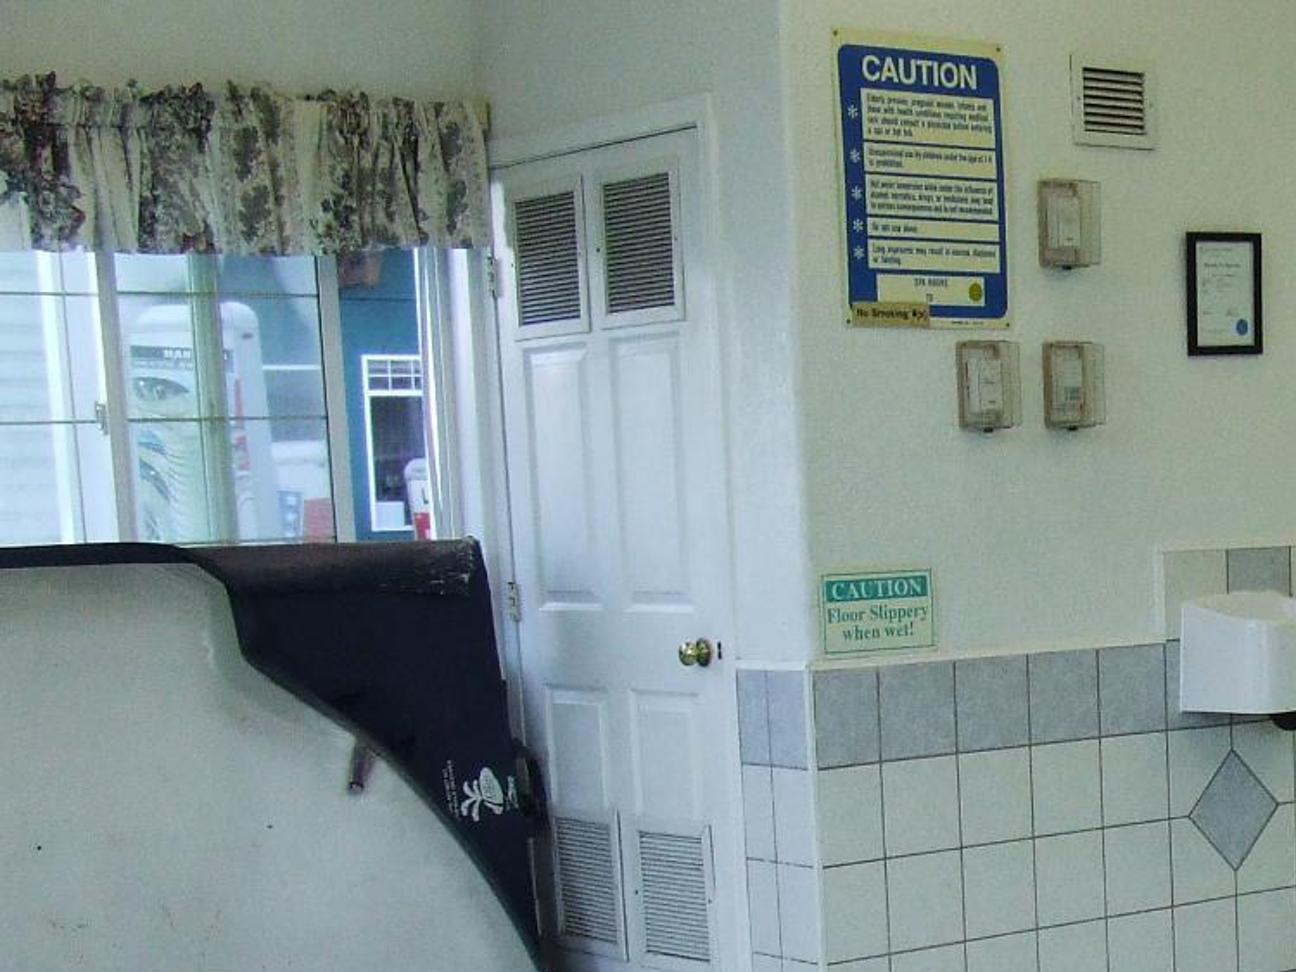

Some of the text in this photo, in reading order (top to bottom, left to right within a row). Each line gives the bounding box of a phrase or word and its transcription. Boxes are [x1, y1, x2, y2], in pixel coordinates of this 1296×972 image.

[861, 54, 978, 90] CAUTION
[856, 308, 909, 320] No Smoking
[832, 578, 922, 599] CAUTION
[828, 604, 928, 624] Floor Slippery
[843, 622, 914, 641] when wet!
